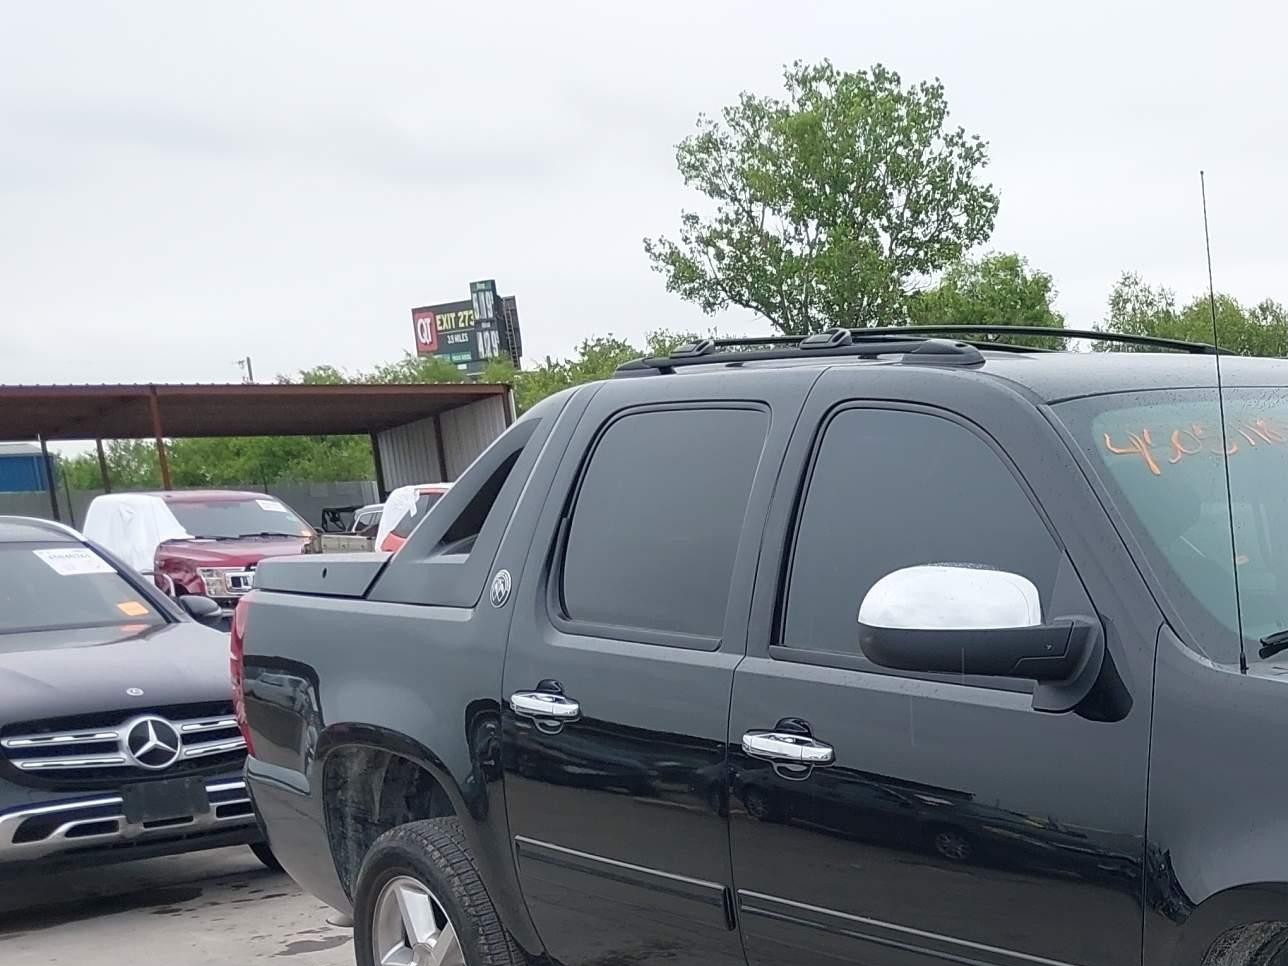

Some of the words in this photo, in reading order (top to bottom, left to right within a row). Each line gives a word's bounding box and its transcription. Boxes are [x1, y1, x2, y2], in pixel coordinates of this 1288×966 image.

[417, 317, 432, 345] QT
[435, 311, 456, 331] EXIT
[457, 309, 474, 328] 273
